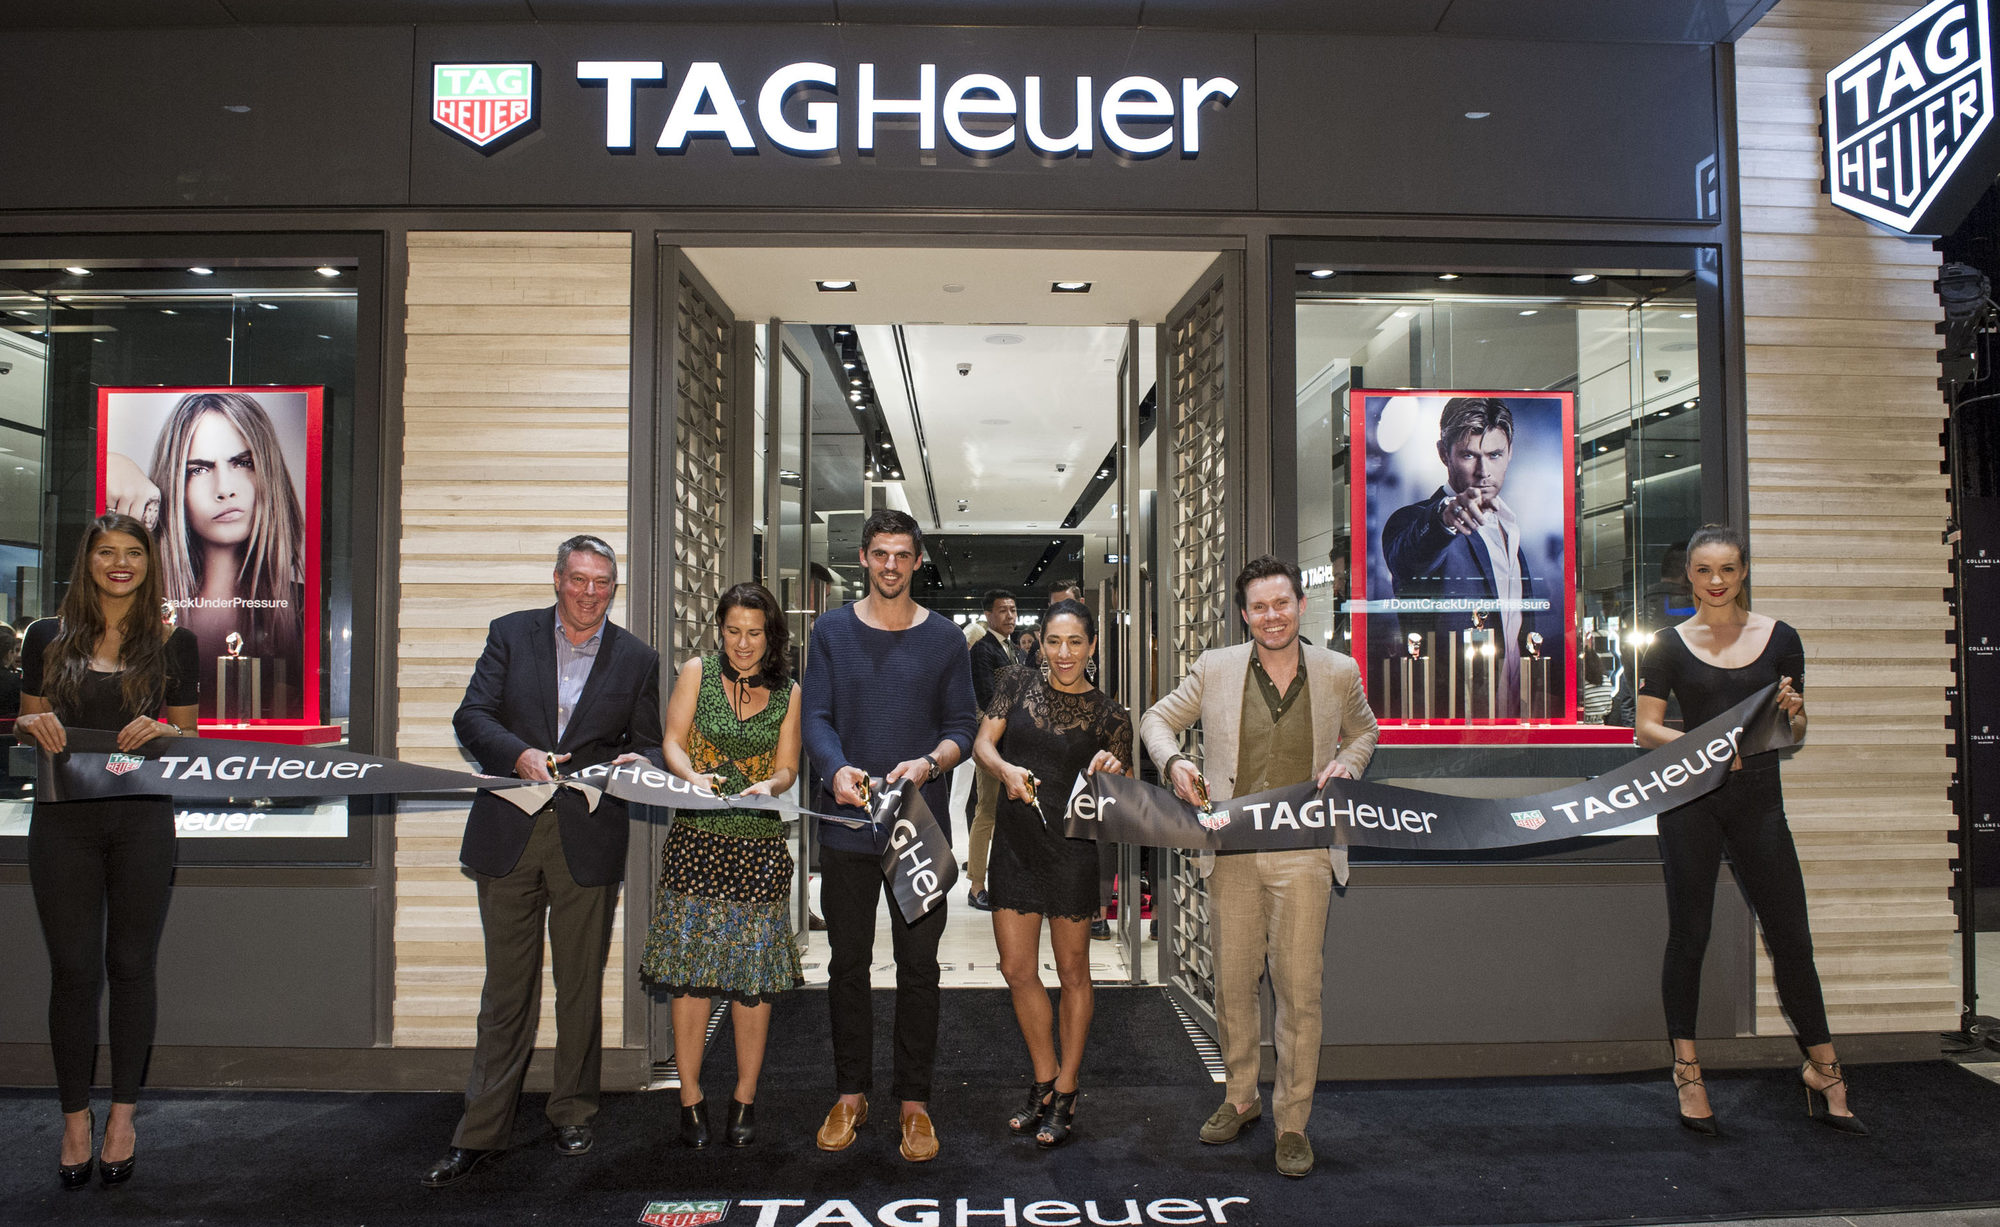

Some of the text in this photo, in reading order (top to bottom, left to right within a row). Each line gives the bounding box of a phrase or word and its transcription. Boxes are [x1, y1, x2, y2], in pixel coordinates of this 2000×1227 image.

[442, 69, 523, 95] TAG
[1842, 4, 1969, 125] TAG
[439, 101, 526, 140] HEUER
[1842, 79, 1978, 208] HEUER
[656, 1203, 719, 1213] TAG
